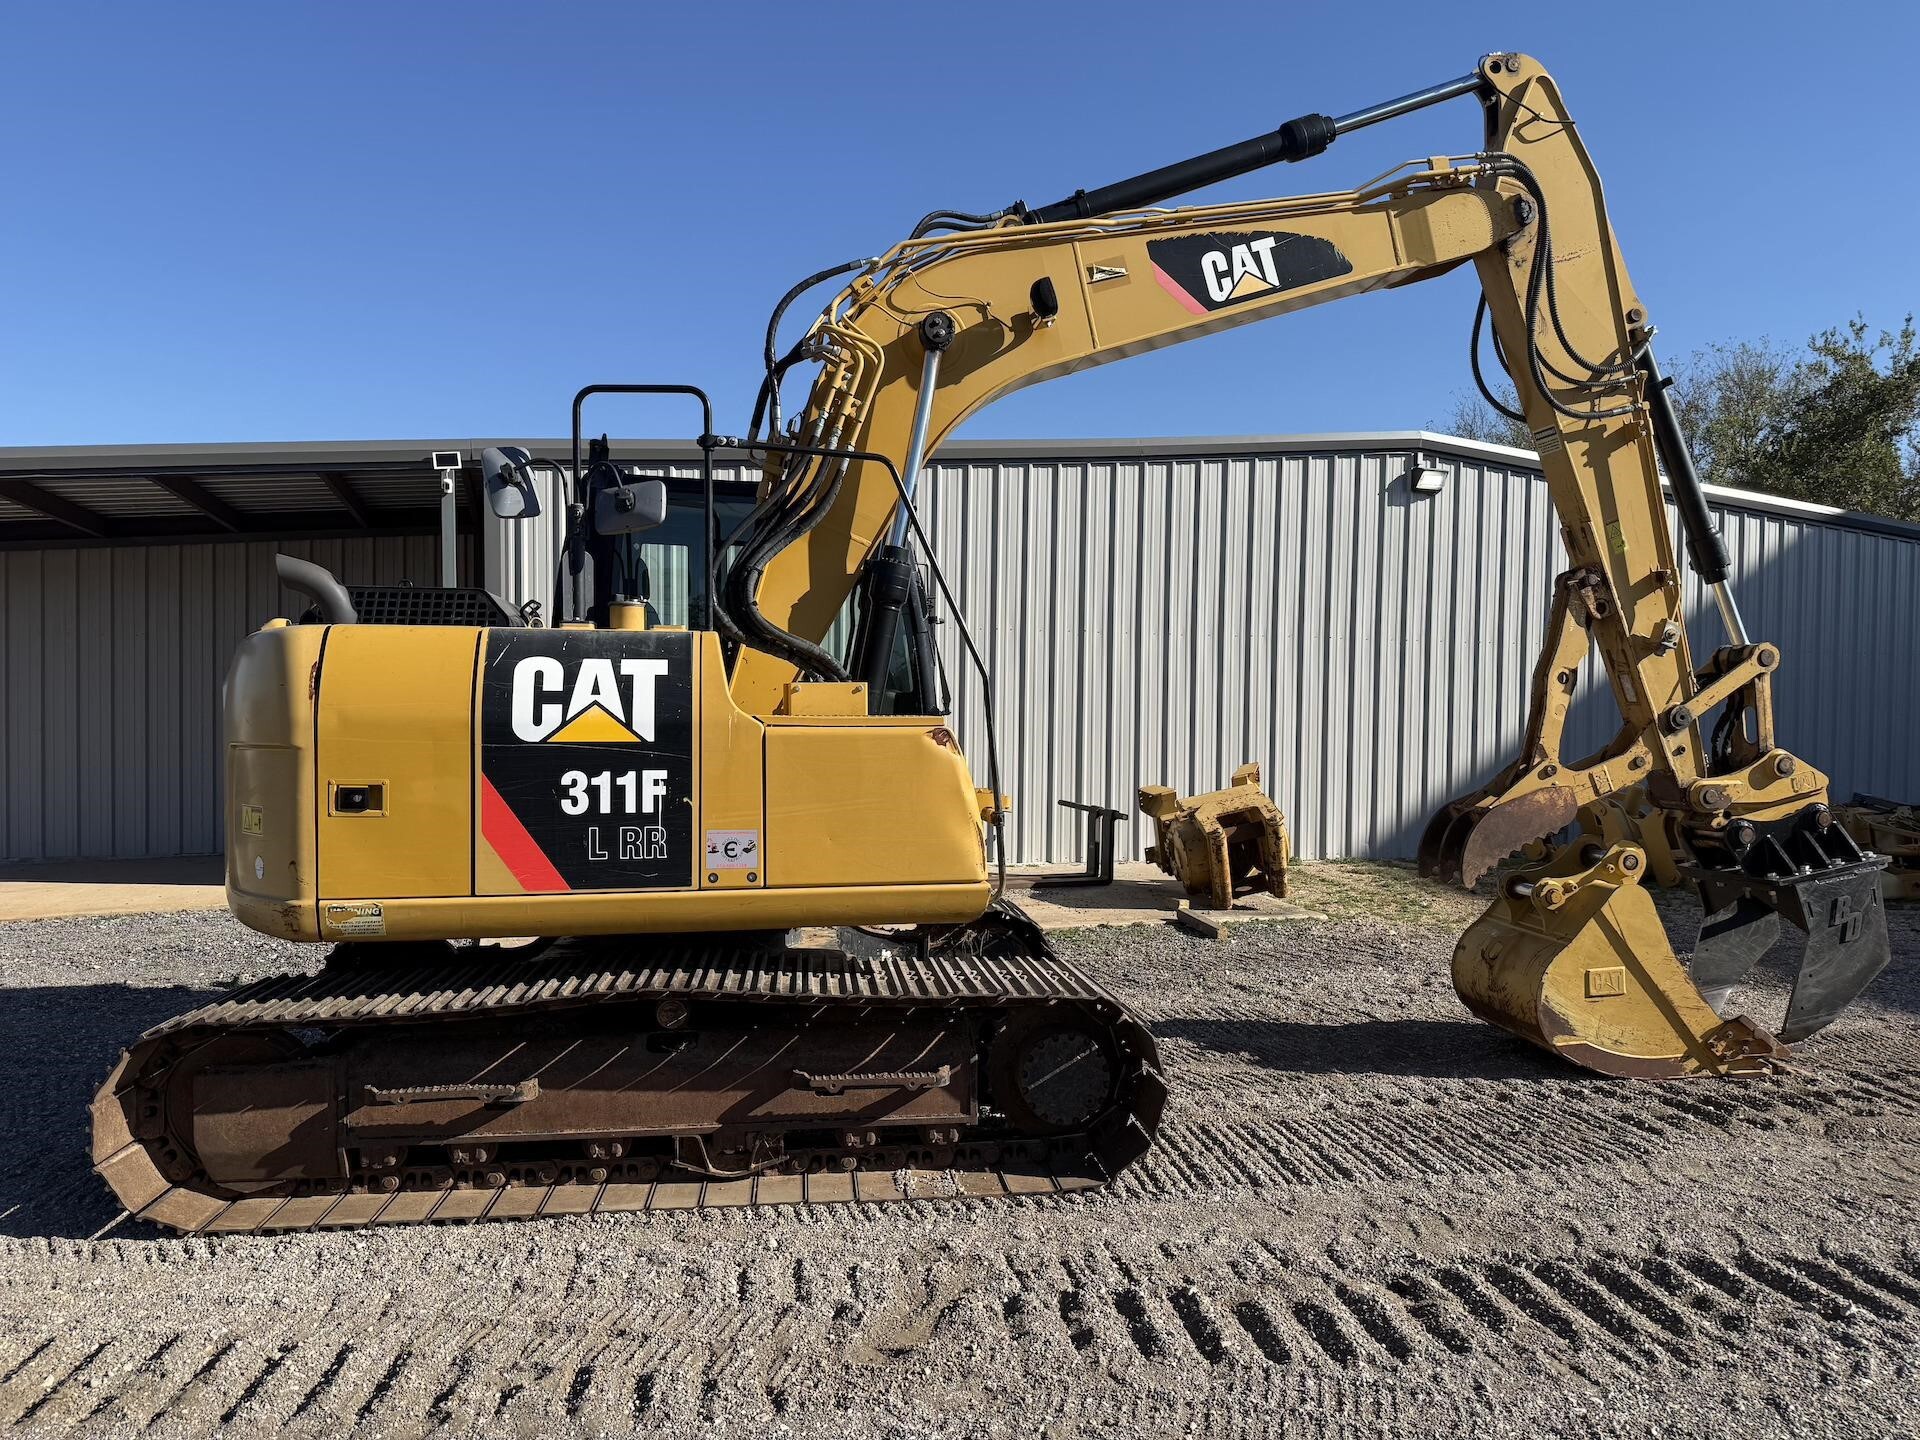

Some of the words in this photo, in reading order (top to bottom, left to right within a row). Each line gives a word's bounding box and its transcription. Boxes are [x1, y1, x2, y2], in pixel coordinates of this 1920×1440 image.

[1201, 236, 1280, 302] CAT
[512, 656, 669, 742] CAT
[560, 770, 668, 815] 311F
[589, 827, 608, 860] L
[620, 826, 668, 860] RR
[1591, 970, 1622, 993] CAT
